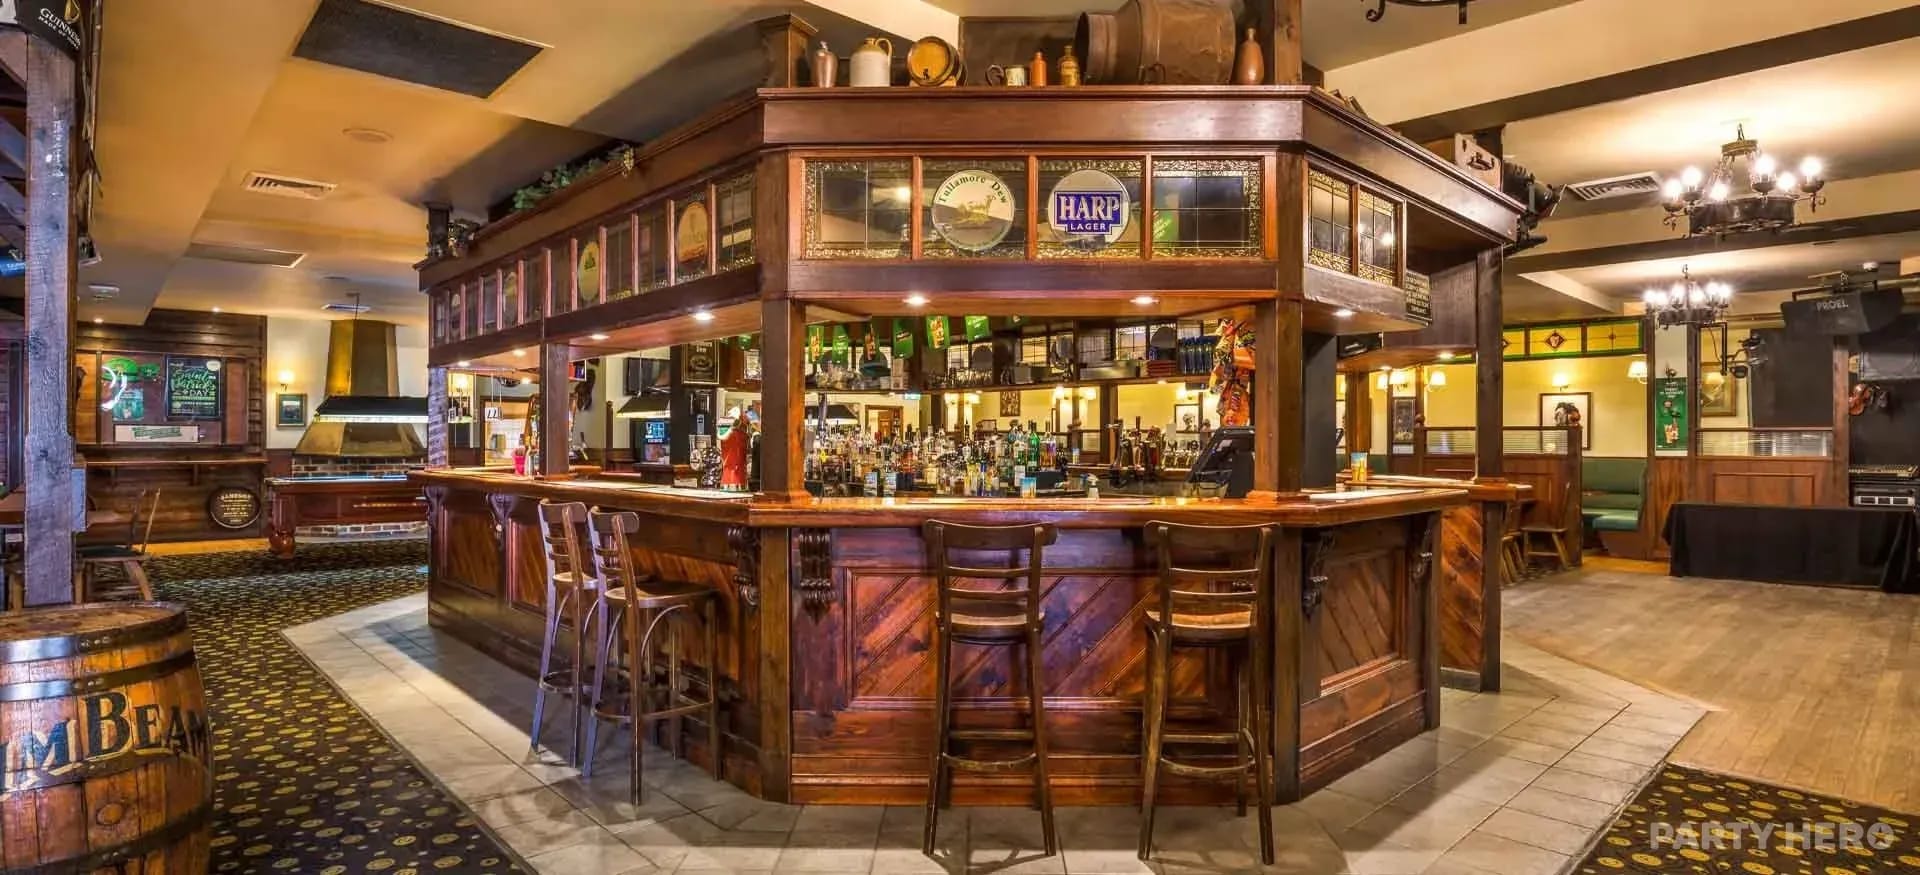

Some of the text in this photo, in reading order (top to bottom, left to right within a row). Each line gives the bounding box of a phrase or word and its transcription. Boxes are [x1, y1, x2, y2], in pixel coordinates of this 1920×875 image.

[939, 175, 1007, 203] Tullamore Dew
[1059, 195, 1120, 221] HARP
[1070, 222, 1106, 231] LAGER
